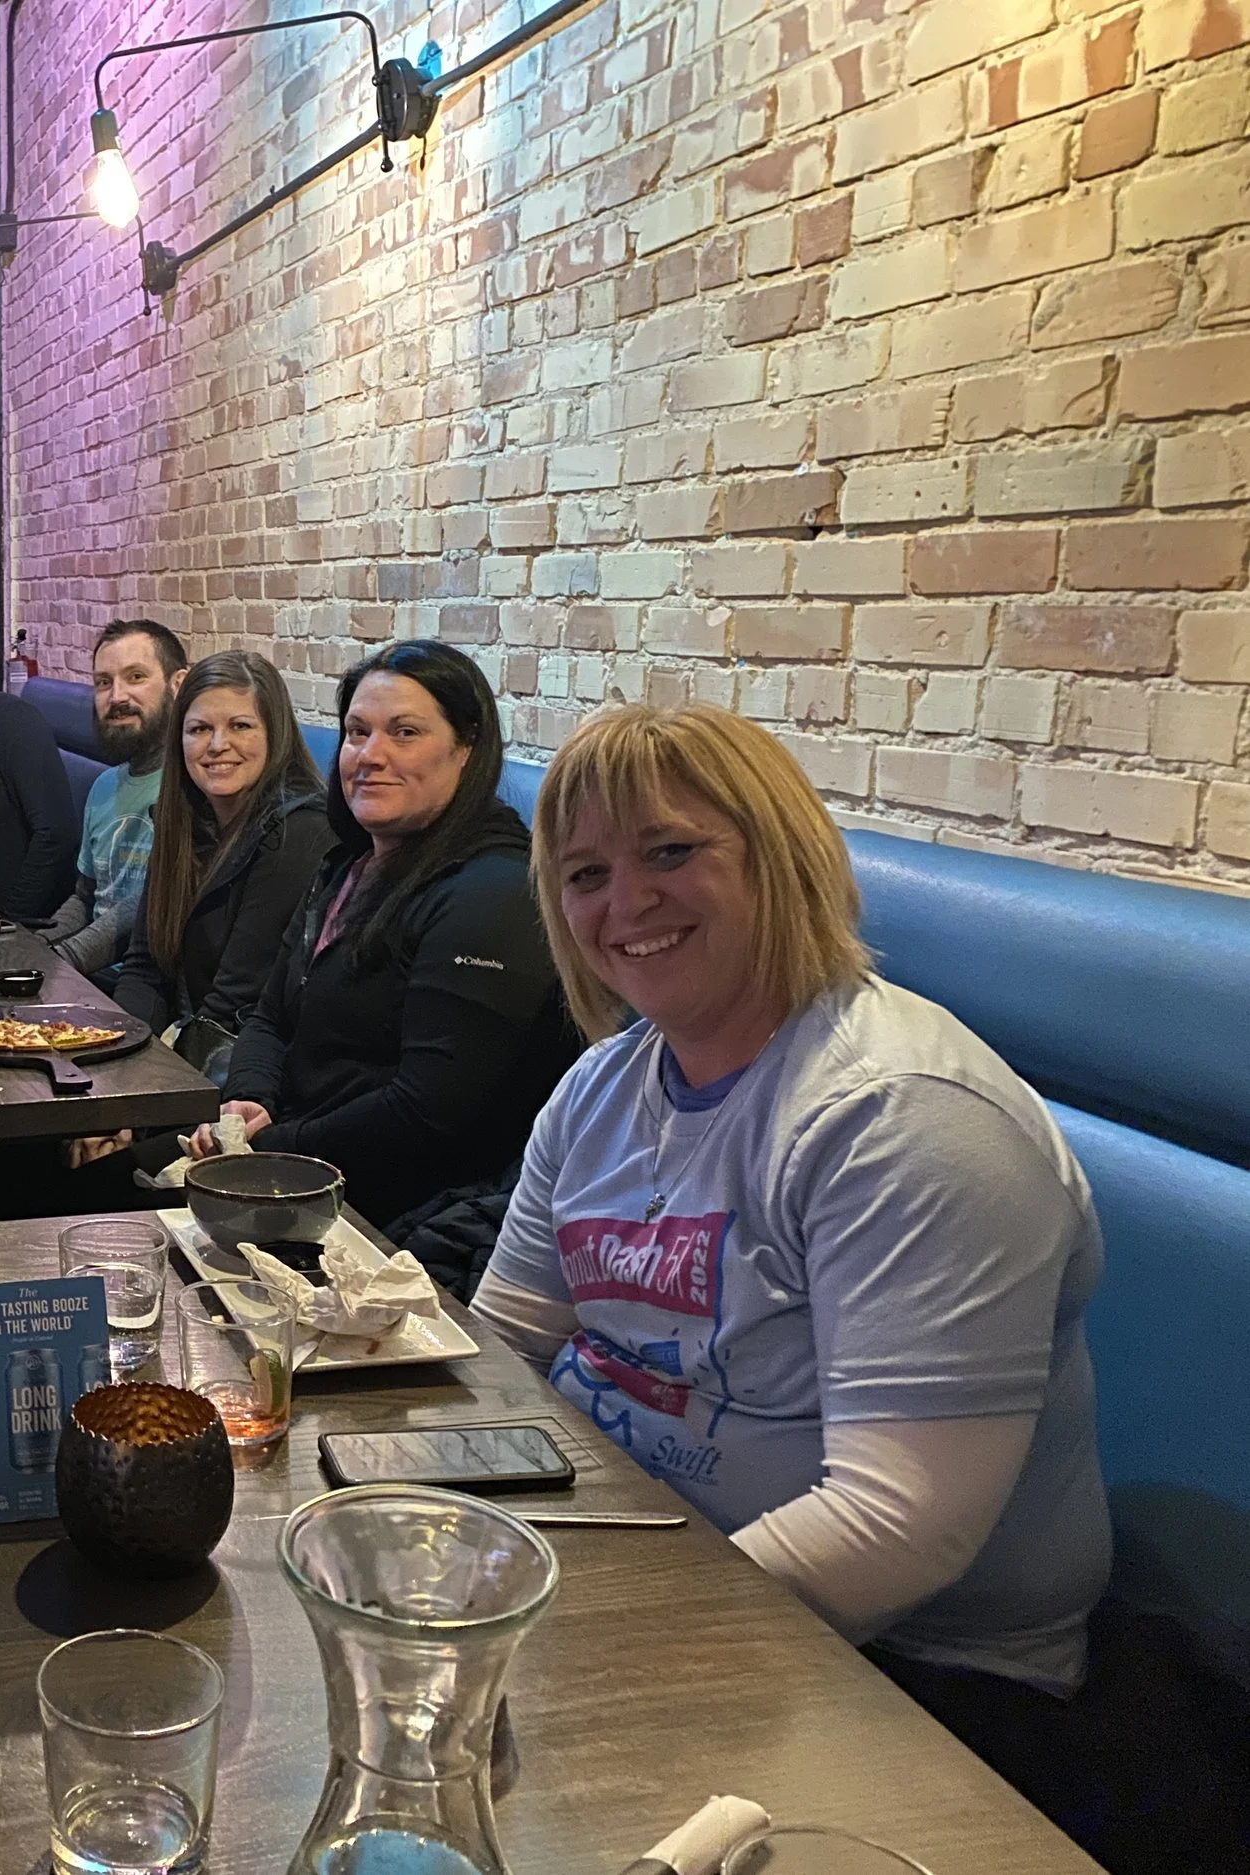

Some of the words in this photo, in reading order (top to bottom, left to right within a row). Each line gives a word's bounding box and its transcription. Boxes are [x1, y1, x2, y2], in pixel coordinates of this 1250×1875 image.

[463, 956, 504, 970] Columbia
[599, 1231, 664, 1290] Dash
[657, 1231, 696, 1299] 5K
[690, 1229, 711, 1307] 2022
[19, 1287, 38, 1298] The
[1, 1299, 49, 1317] TASTING
[52, 1296, 90, 1313] BOOZE
[6, 1318, 28, 1335] THE
[13, 1384, 56, 1410] LONG
[11, 1408, 62, 1433] DRINK
[650, 1435, 723, 1479] Swift
